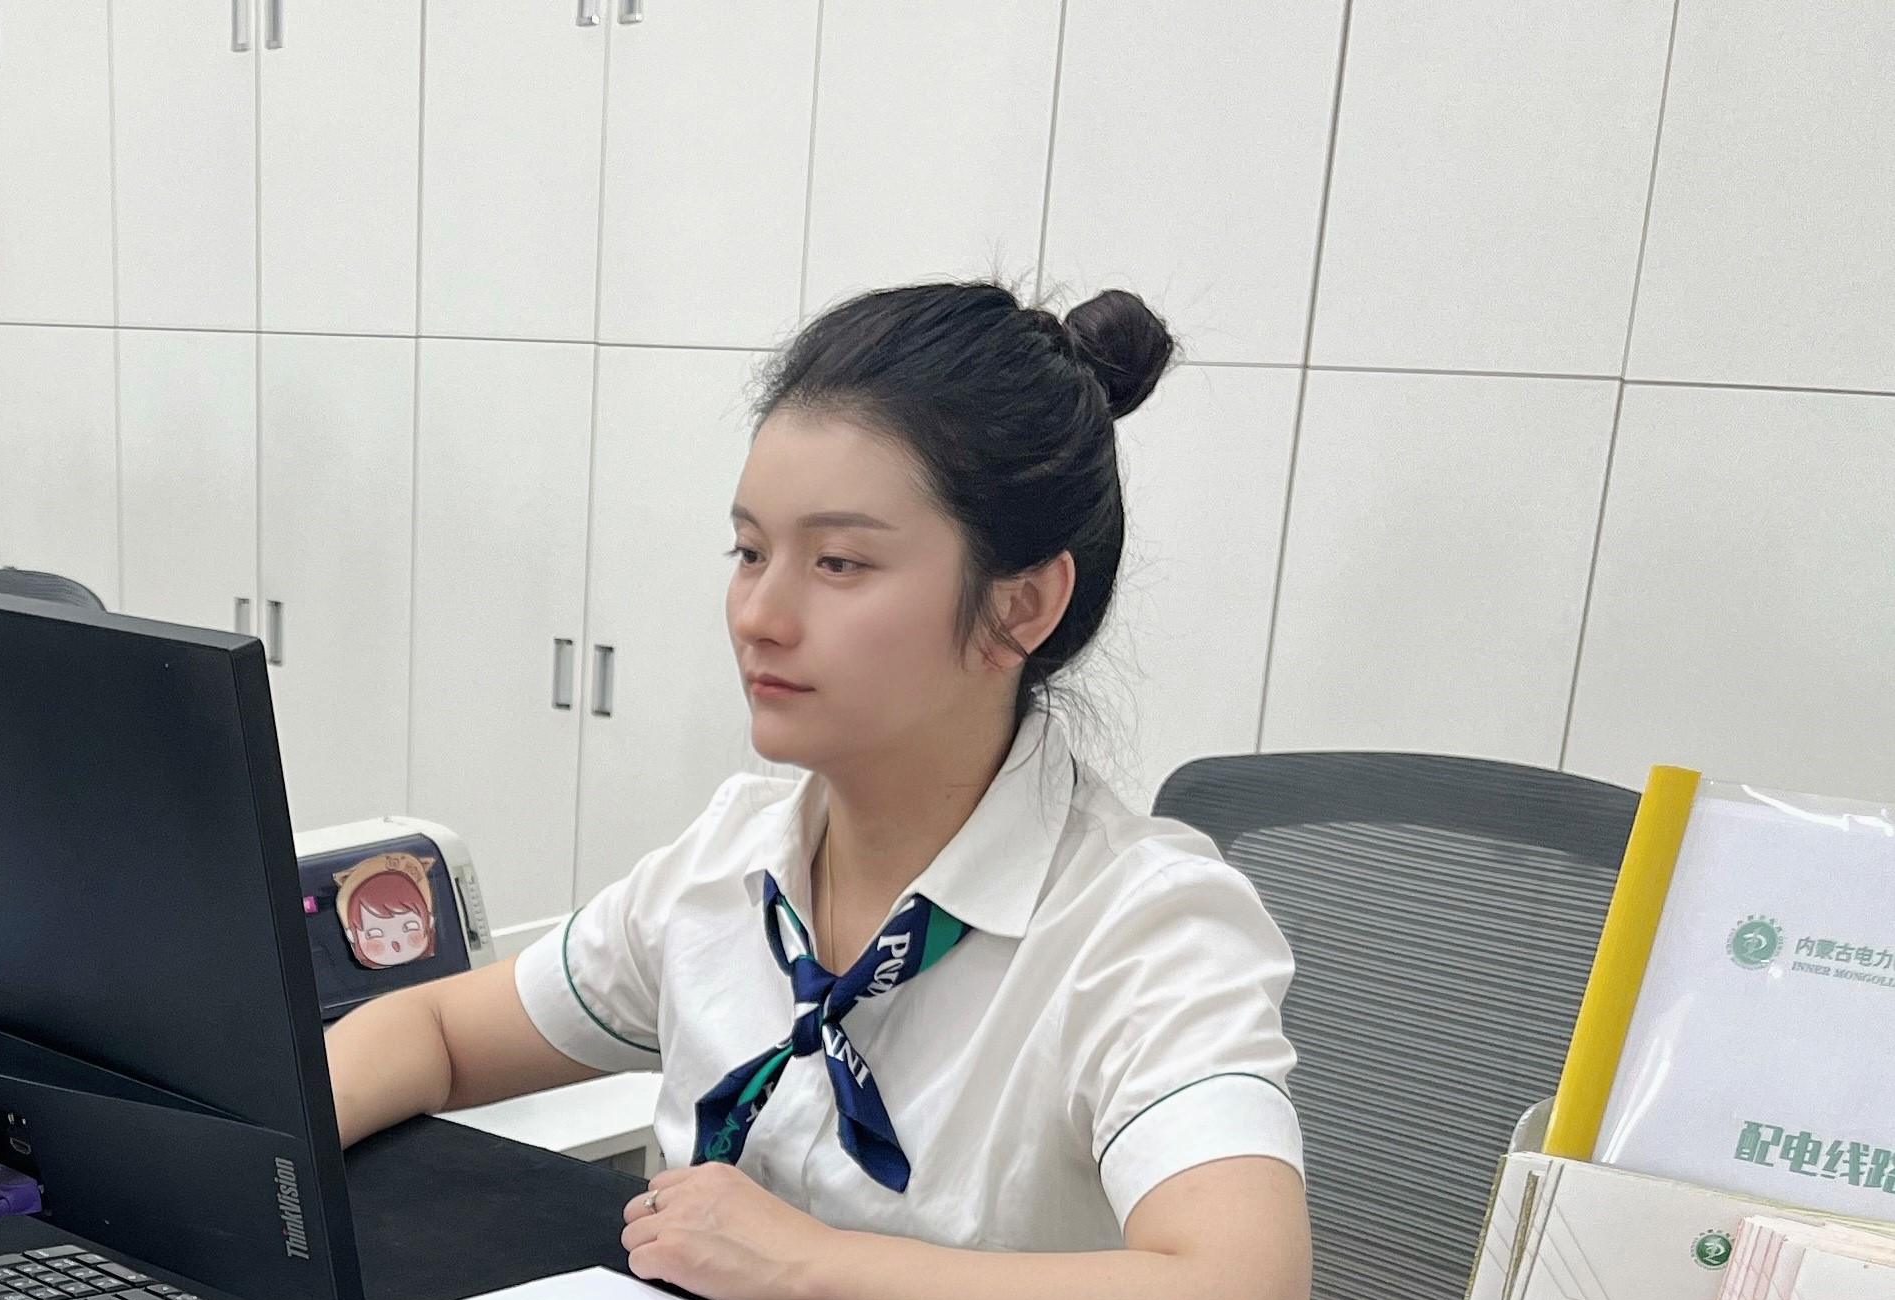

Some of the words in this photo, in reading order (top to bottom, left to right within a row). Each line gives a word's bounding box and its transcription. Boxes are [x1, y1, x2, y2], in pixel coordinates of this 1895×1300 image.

[1794, 936, 1895, 970] 内蒙古电力
[274, 1157, 310, 1260] ThinkVision
